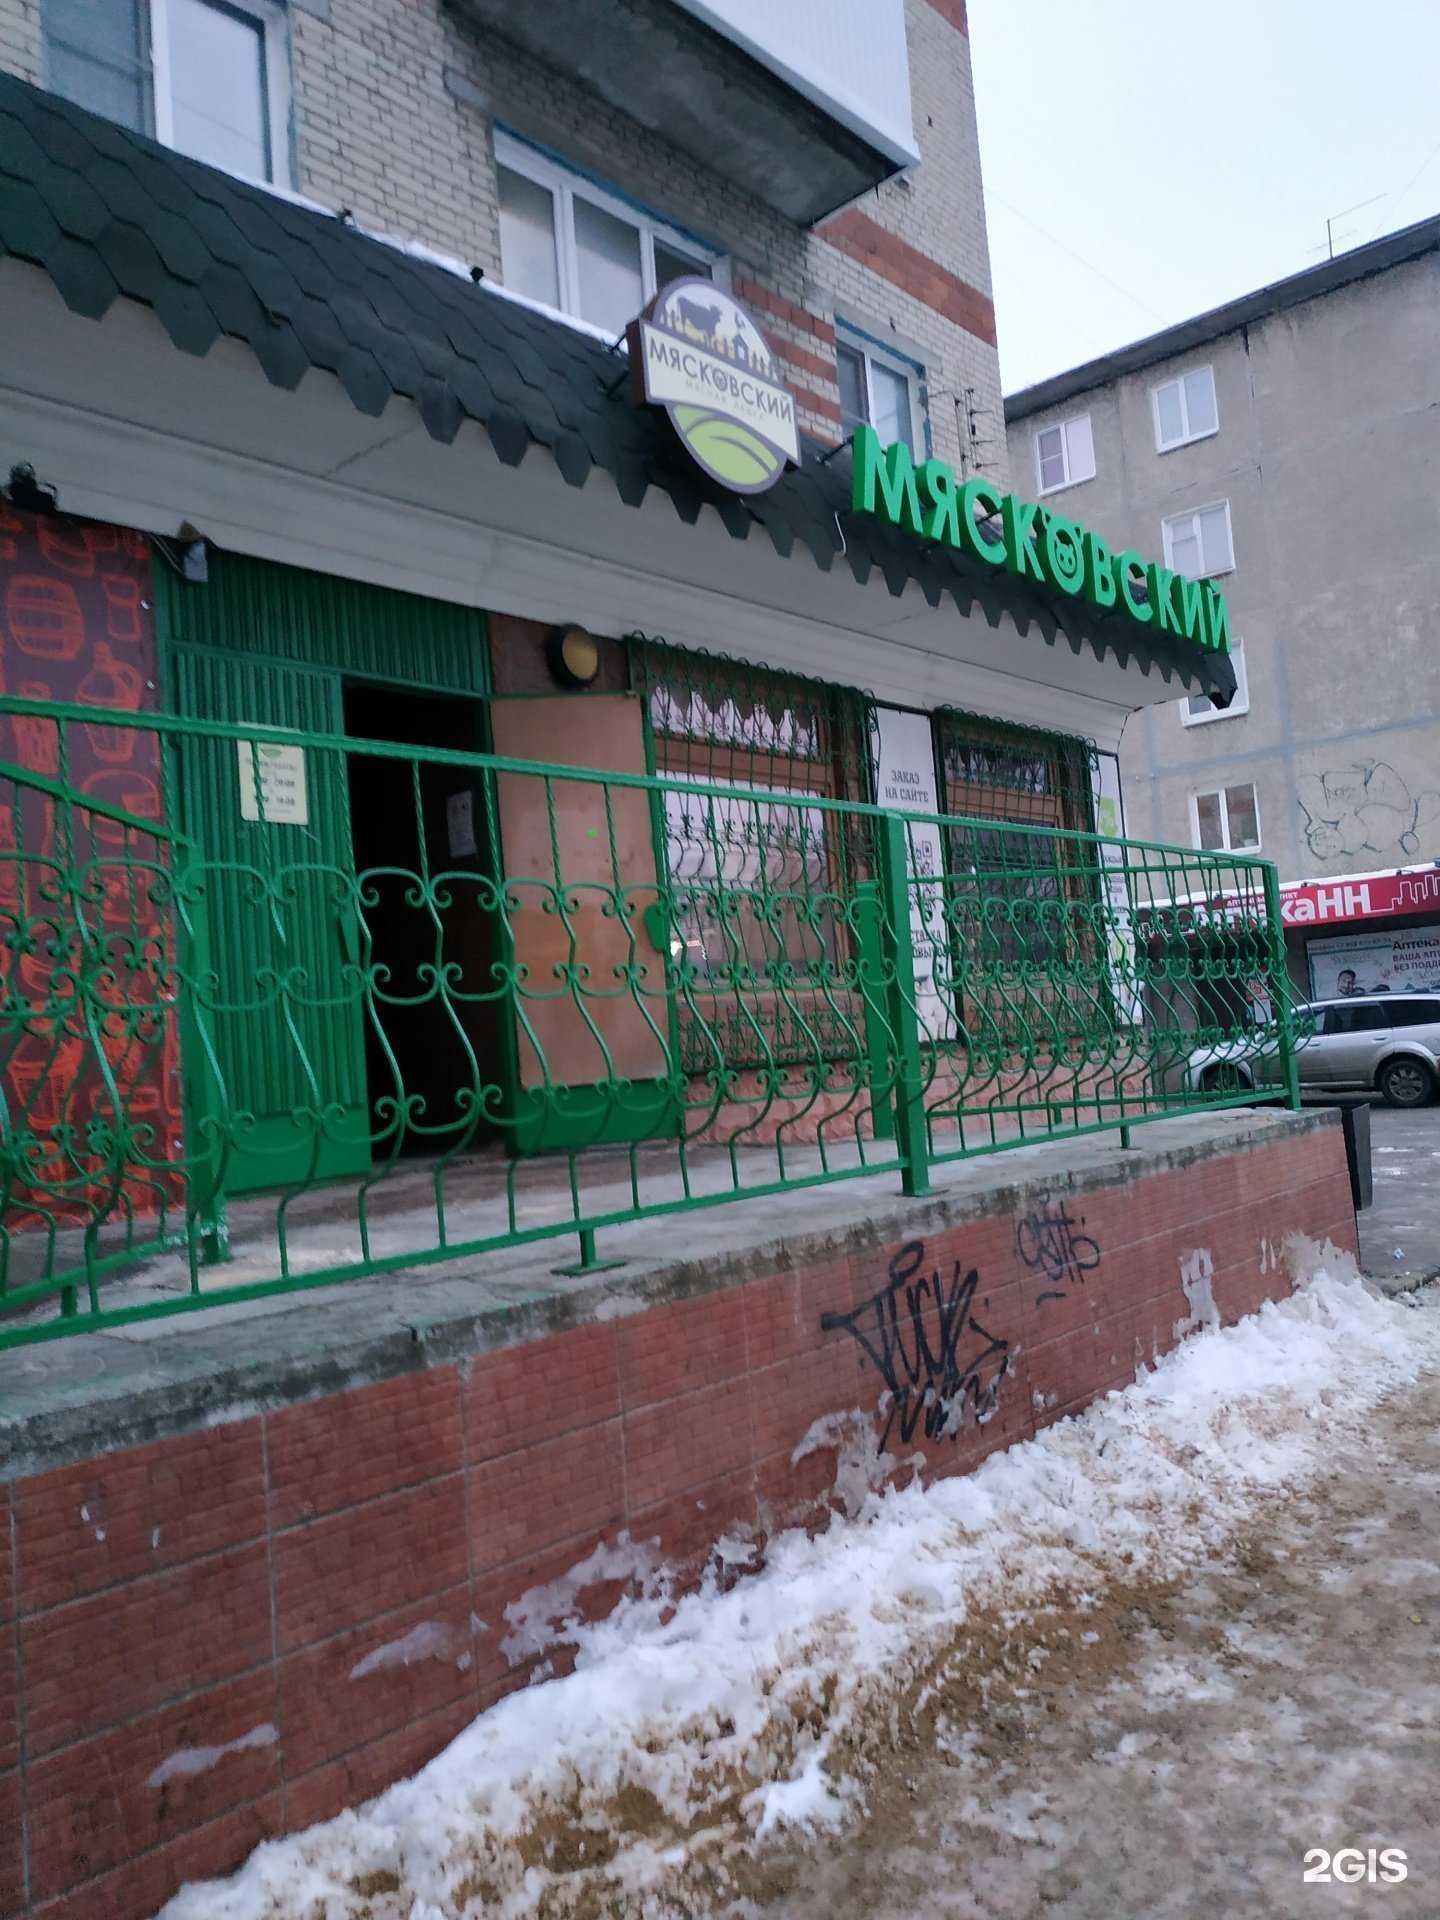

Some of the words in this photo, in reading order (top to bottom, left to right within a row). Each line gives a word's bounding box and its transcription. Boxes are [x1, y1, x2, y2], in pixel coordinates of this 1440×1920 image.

[650, 336, 793, 423] МЯСКОВСКИЙ
[853, 423, 1232, 656] МЯСКОВСКИЙ
[885, 786, 898, 799] НА
[891, 769, 920, 785] ЗАКАЗ
